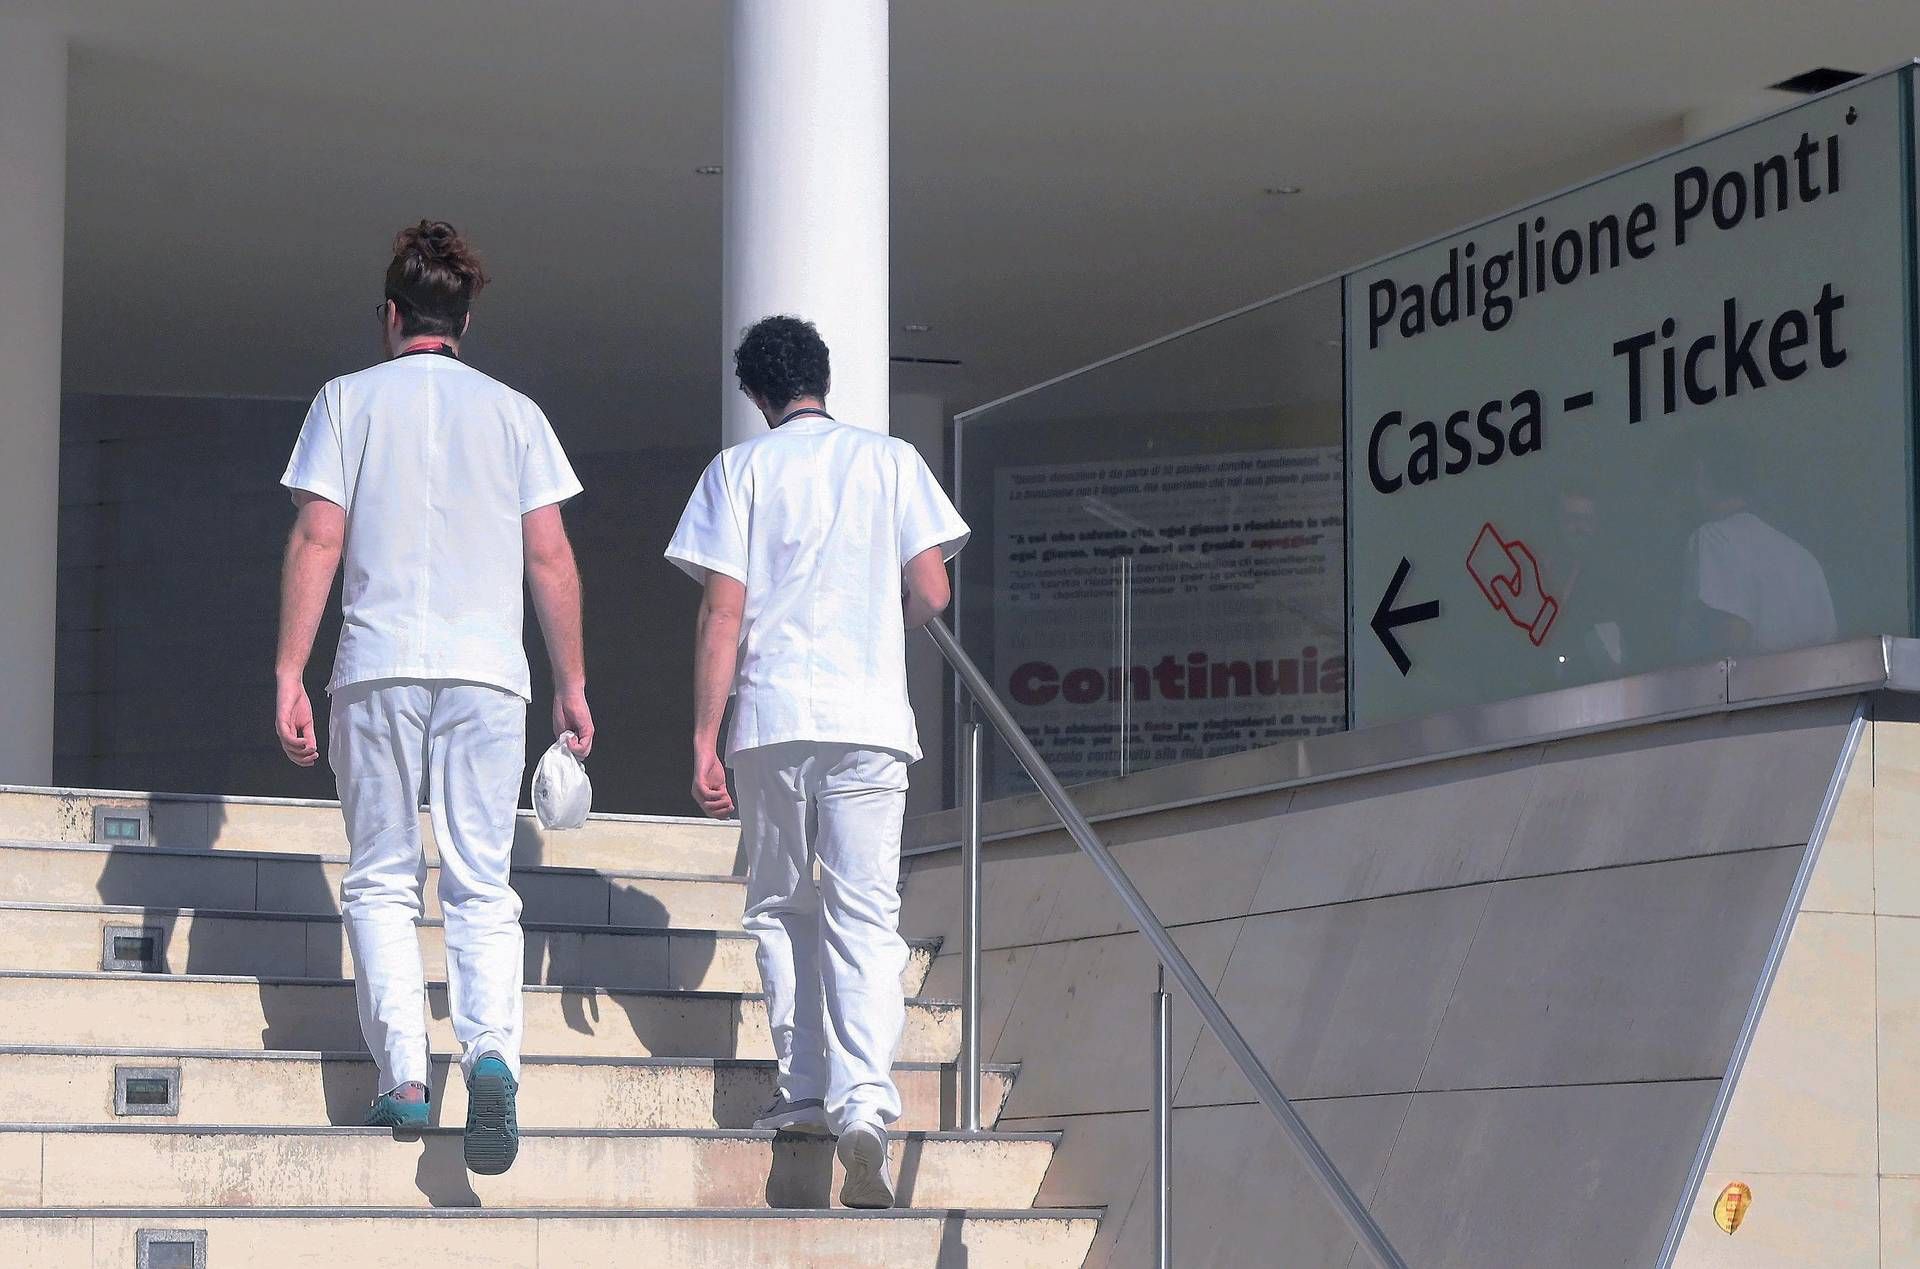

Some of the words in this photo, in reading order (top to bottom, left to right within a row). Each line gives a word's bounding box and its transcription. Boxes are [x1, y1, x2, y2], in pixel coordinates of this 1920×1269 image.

[1369, 202, 1657, 349] Padiglione
[1674, 106, 1857, 247] Ponti
[1367, 389, 1542, 495] Cassa
[1612, 282, 1848, 425] Ticket
